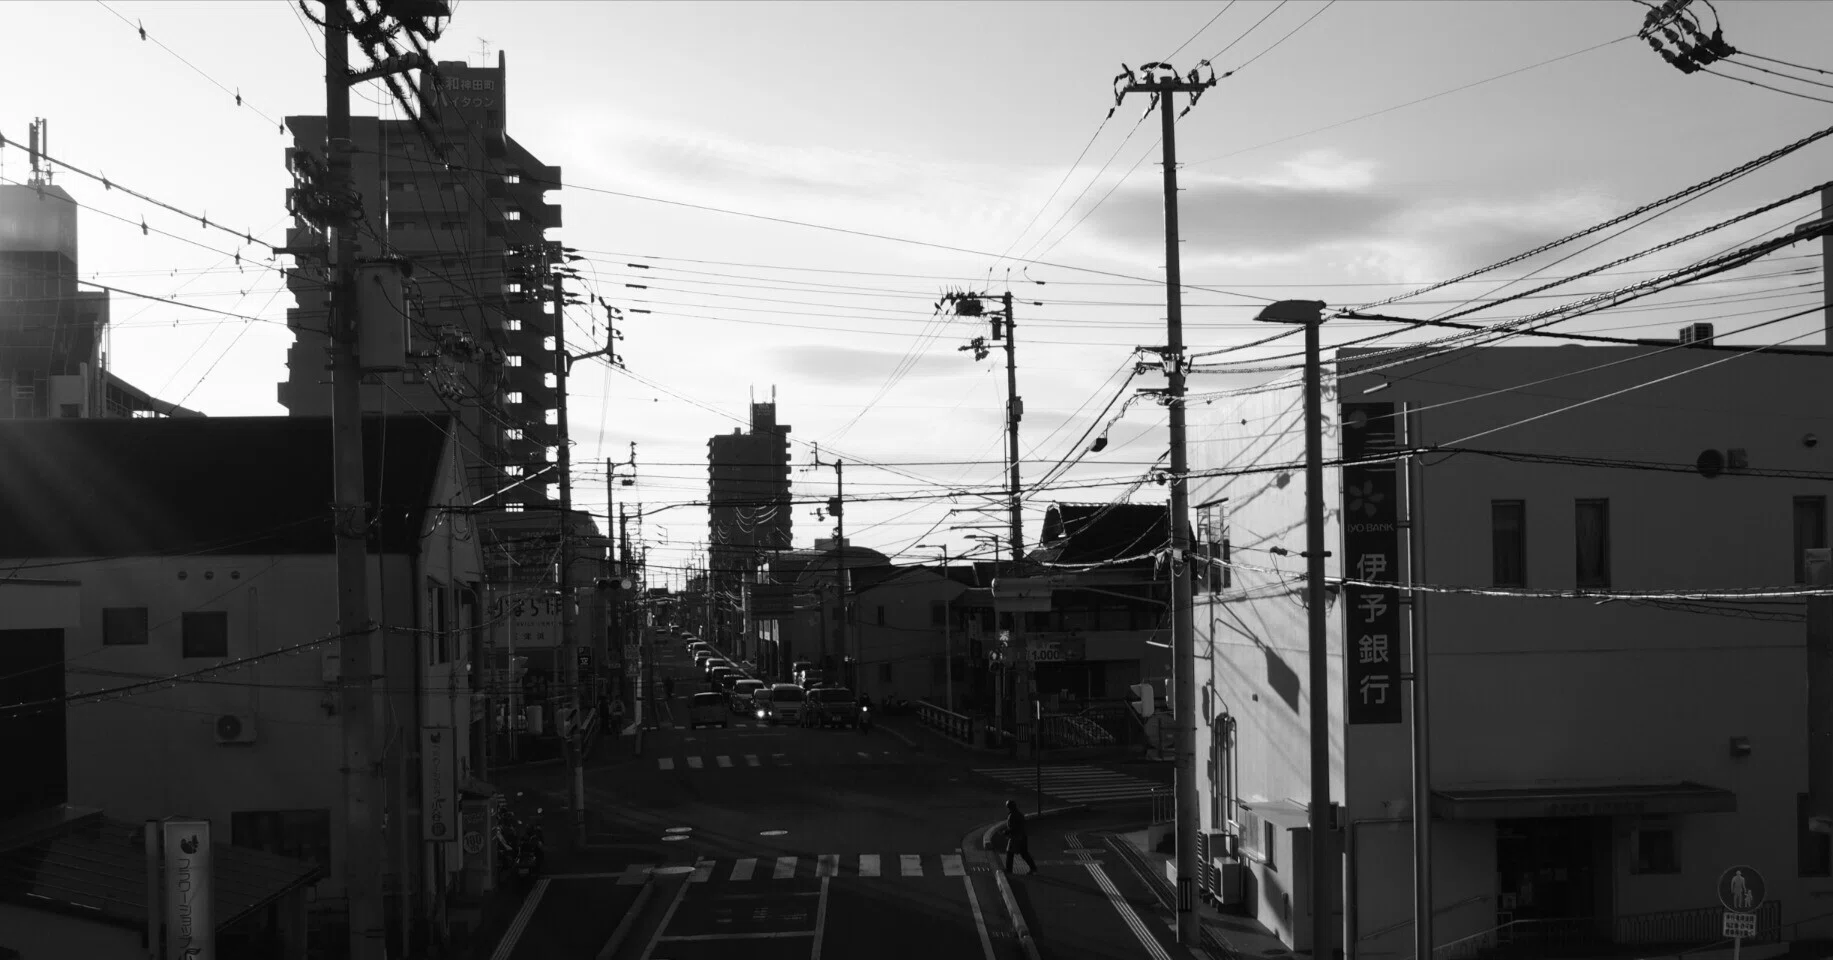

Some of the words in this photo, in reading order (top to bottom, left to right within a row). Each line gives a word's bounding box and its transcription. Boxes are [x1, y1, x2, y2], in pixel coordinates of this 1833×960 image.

[431, 75, 495, 91] 和神田町
[1347, 523, 1364, 533] IYO
[1366, 522, 1395, 532] BANK
[1356, 553, 1390, 705] 伊予銀行
